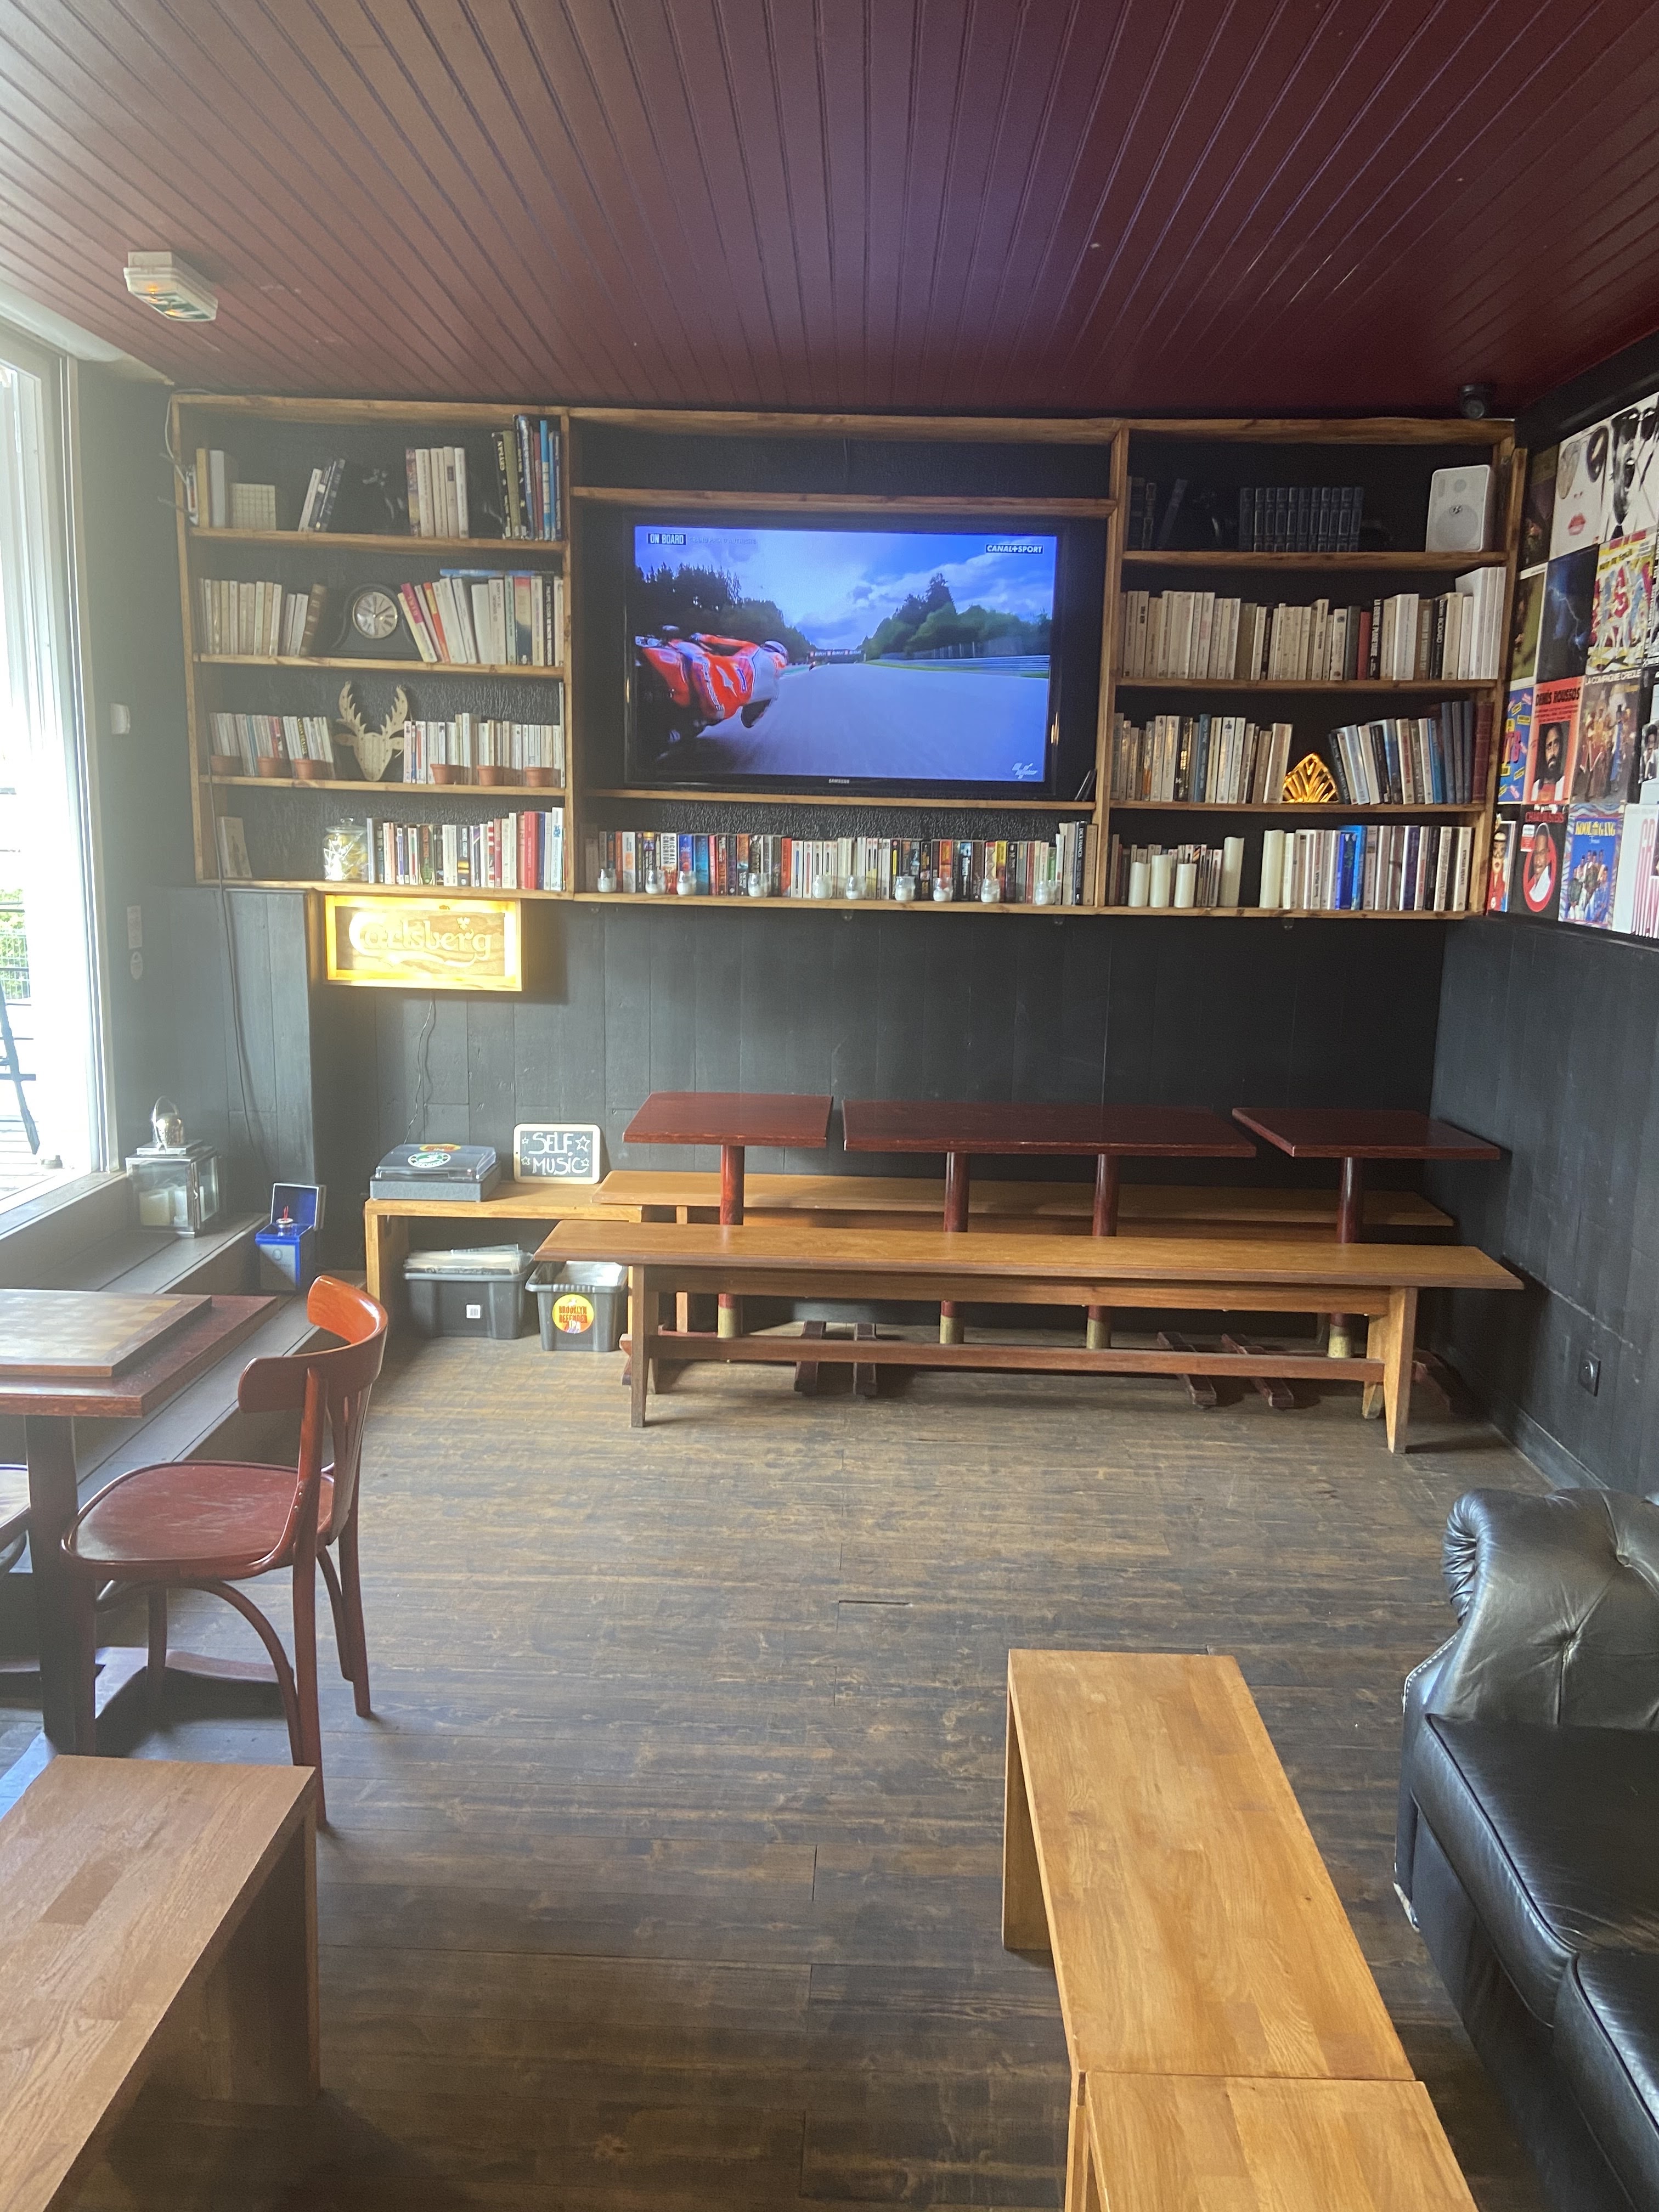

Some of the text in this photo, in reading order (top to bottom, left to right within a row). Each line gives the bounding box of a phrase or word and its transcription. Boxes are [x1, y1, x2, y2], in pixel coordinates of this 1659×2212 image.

[650, 534, 684, 544] ON BOARD
[1575, 821, 1592, 835] KOOL
[349, 911, 492, 961] Carlsberg
[528, 1131, 574, 1155] SELF
[558, 1306, 587, 1314] BROOKLYN
[558, 1314, 588, 1323] DEFENDER
[568, 1320, 581, 1330] IPA
